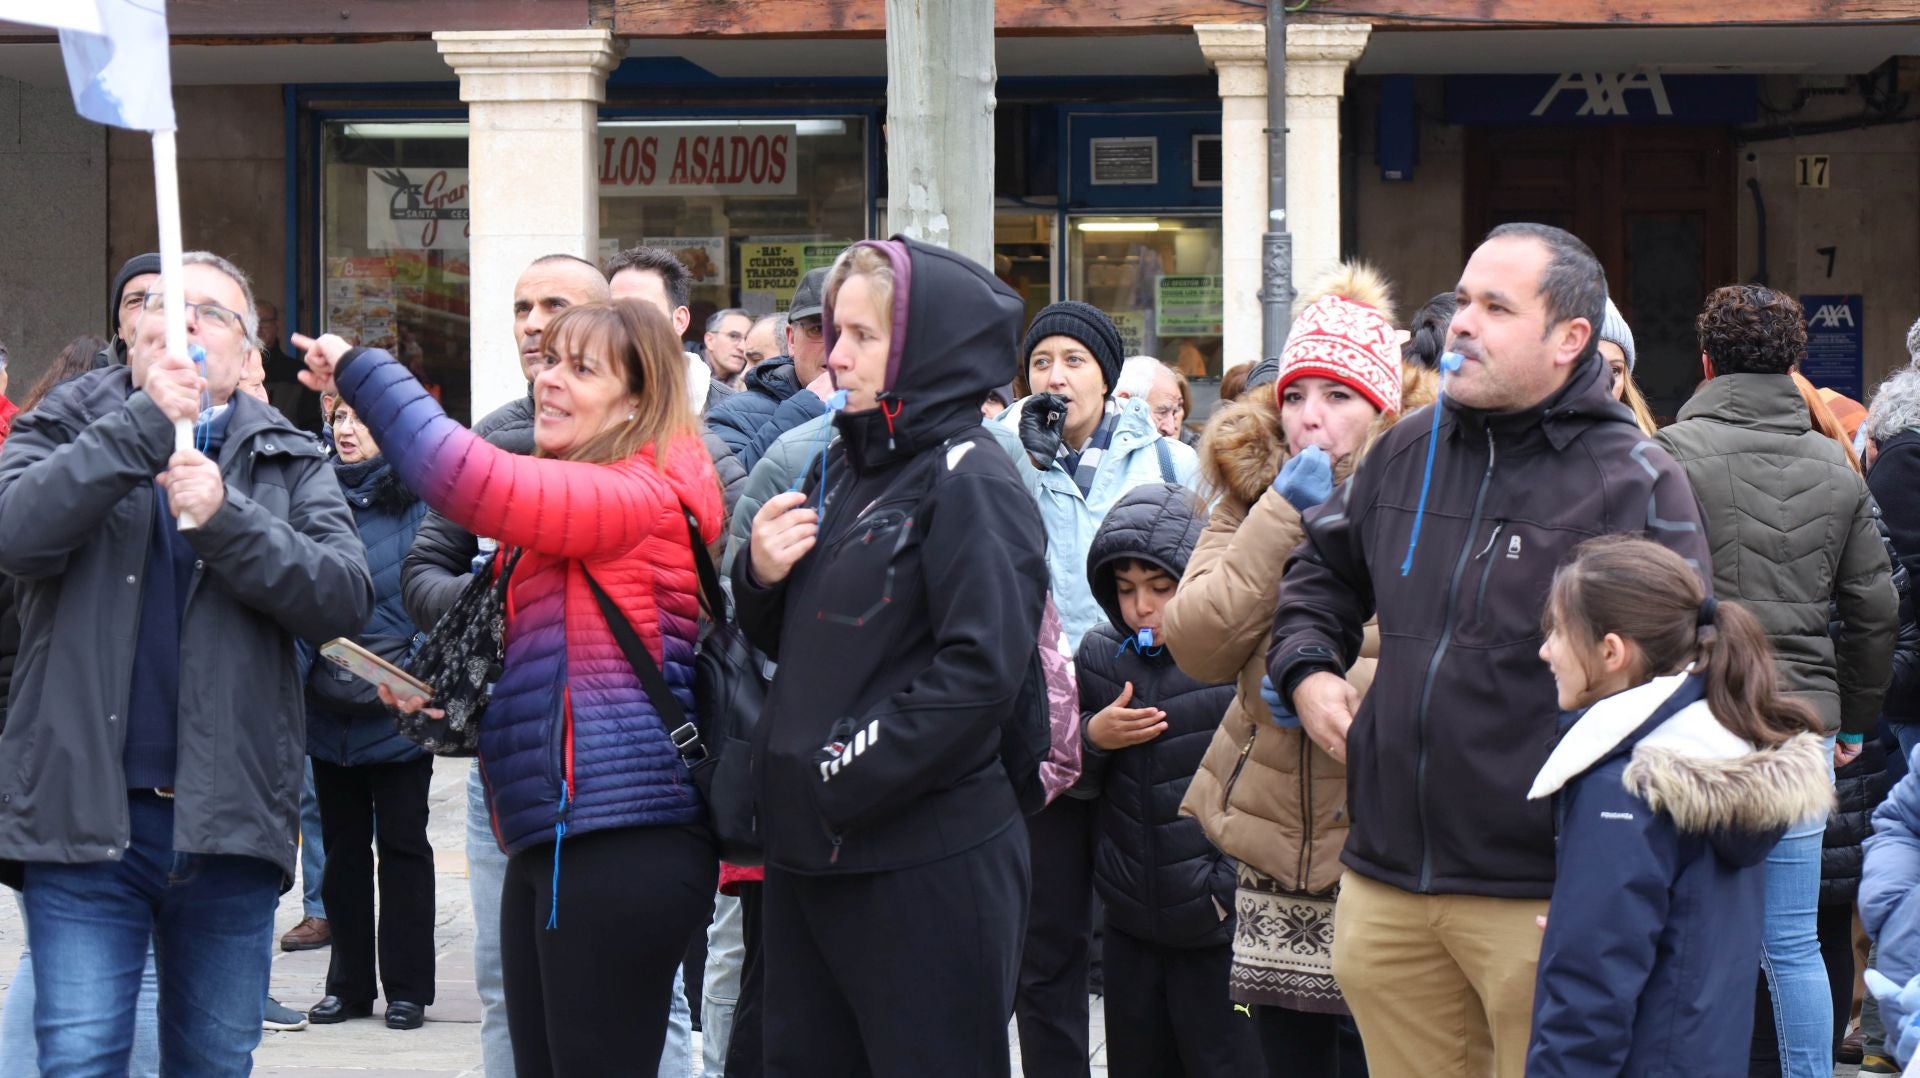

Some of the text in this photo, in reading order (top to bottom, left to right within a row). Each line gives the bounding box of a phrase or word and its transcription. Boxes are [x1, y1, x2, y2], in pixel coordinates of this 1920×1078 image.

[1530, 73, 1673, 115] AXA
[599, 135, 788, 186] LOS ASADOS
[1799, 157, 1828, 186] 17
[406, 210, 437, 218] SANTA
[762, 246, 782, 256] HAY
[749, 257, 795, 267] CUARTOS
[1816, 246, 1836, 279] 7
[746, 268, 799, 278] TRASEROS
[748, 279, 796, 289] DE POLLO
[1808, 304, 1855, 328] AXA
